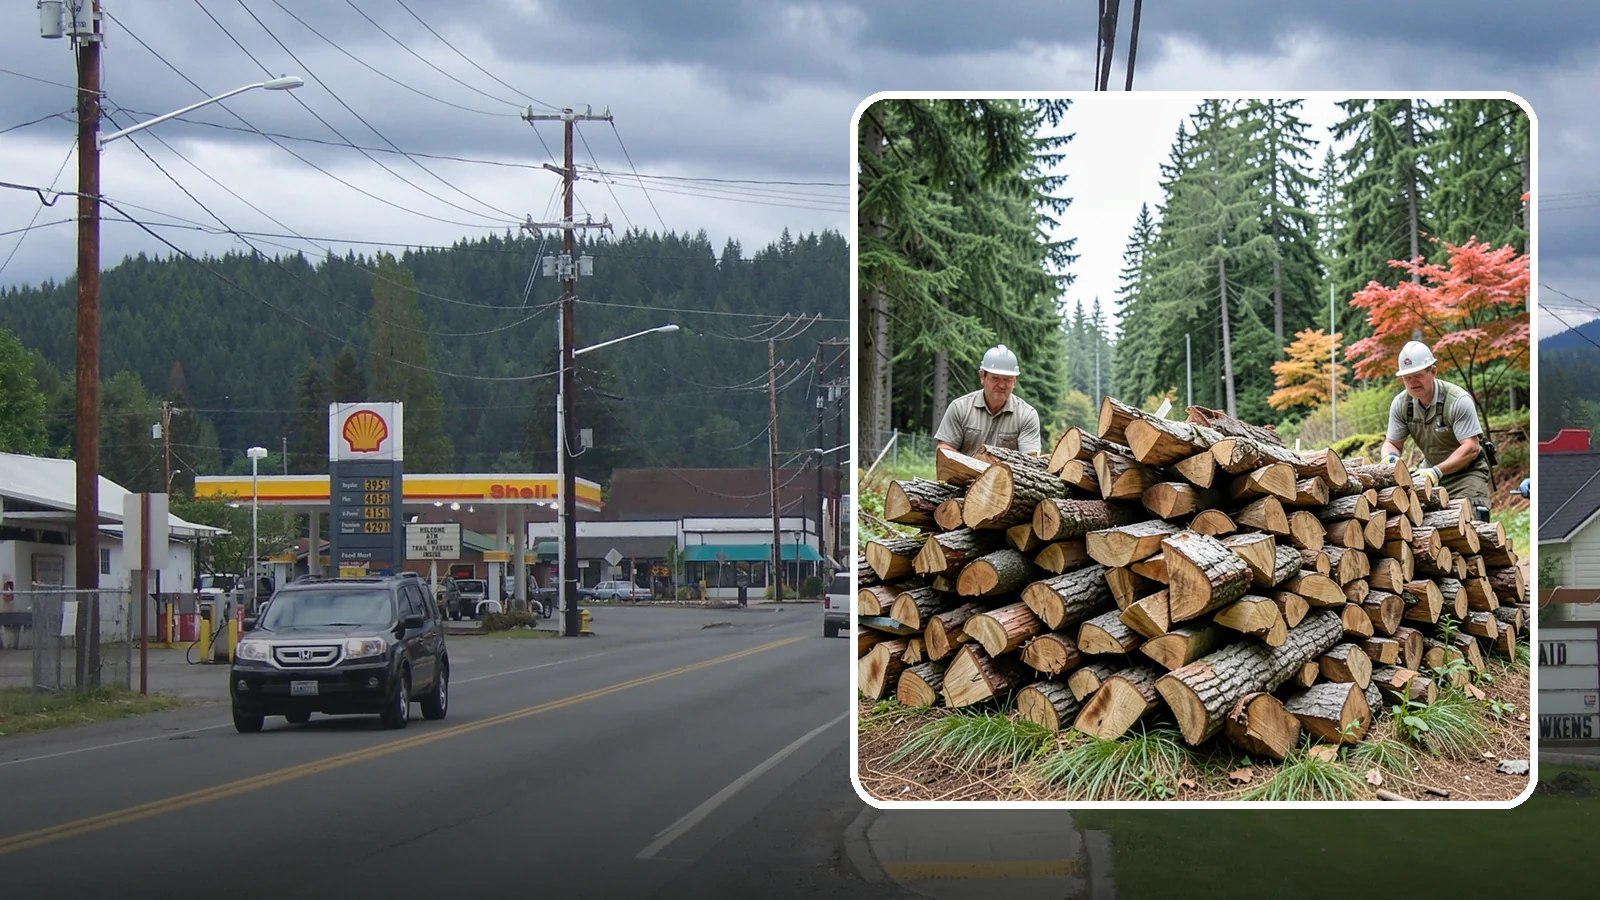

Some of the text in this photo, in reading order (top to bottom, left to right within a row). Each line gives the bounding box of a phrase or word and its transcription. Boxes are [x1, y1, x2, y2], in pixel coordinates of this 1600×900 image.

[366, 480, 383, 490] 395
[490, 484, 547, 499] Shell
[366, 494, 383, 504] 405
[366, 508, 383, 518] 415
[366, 522, 383, 532] 429
